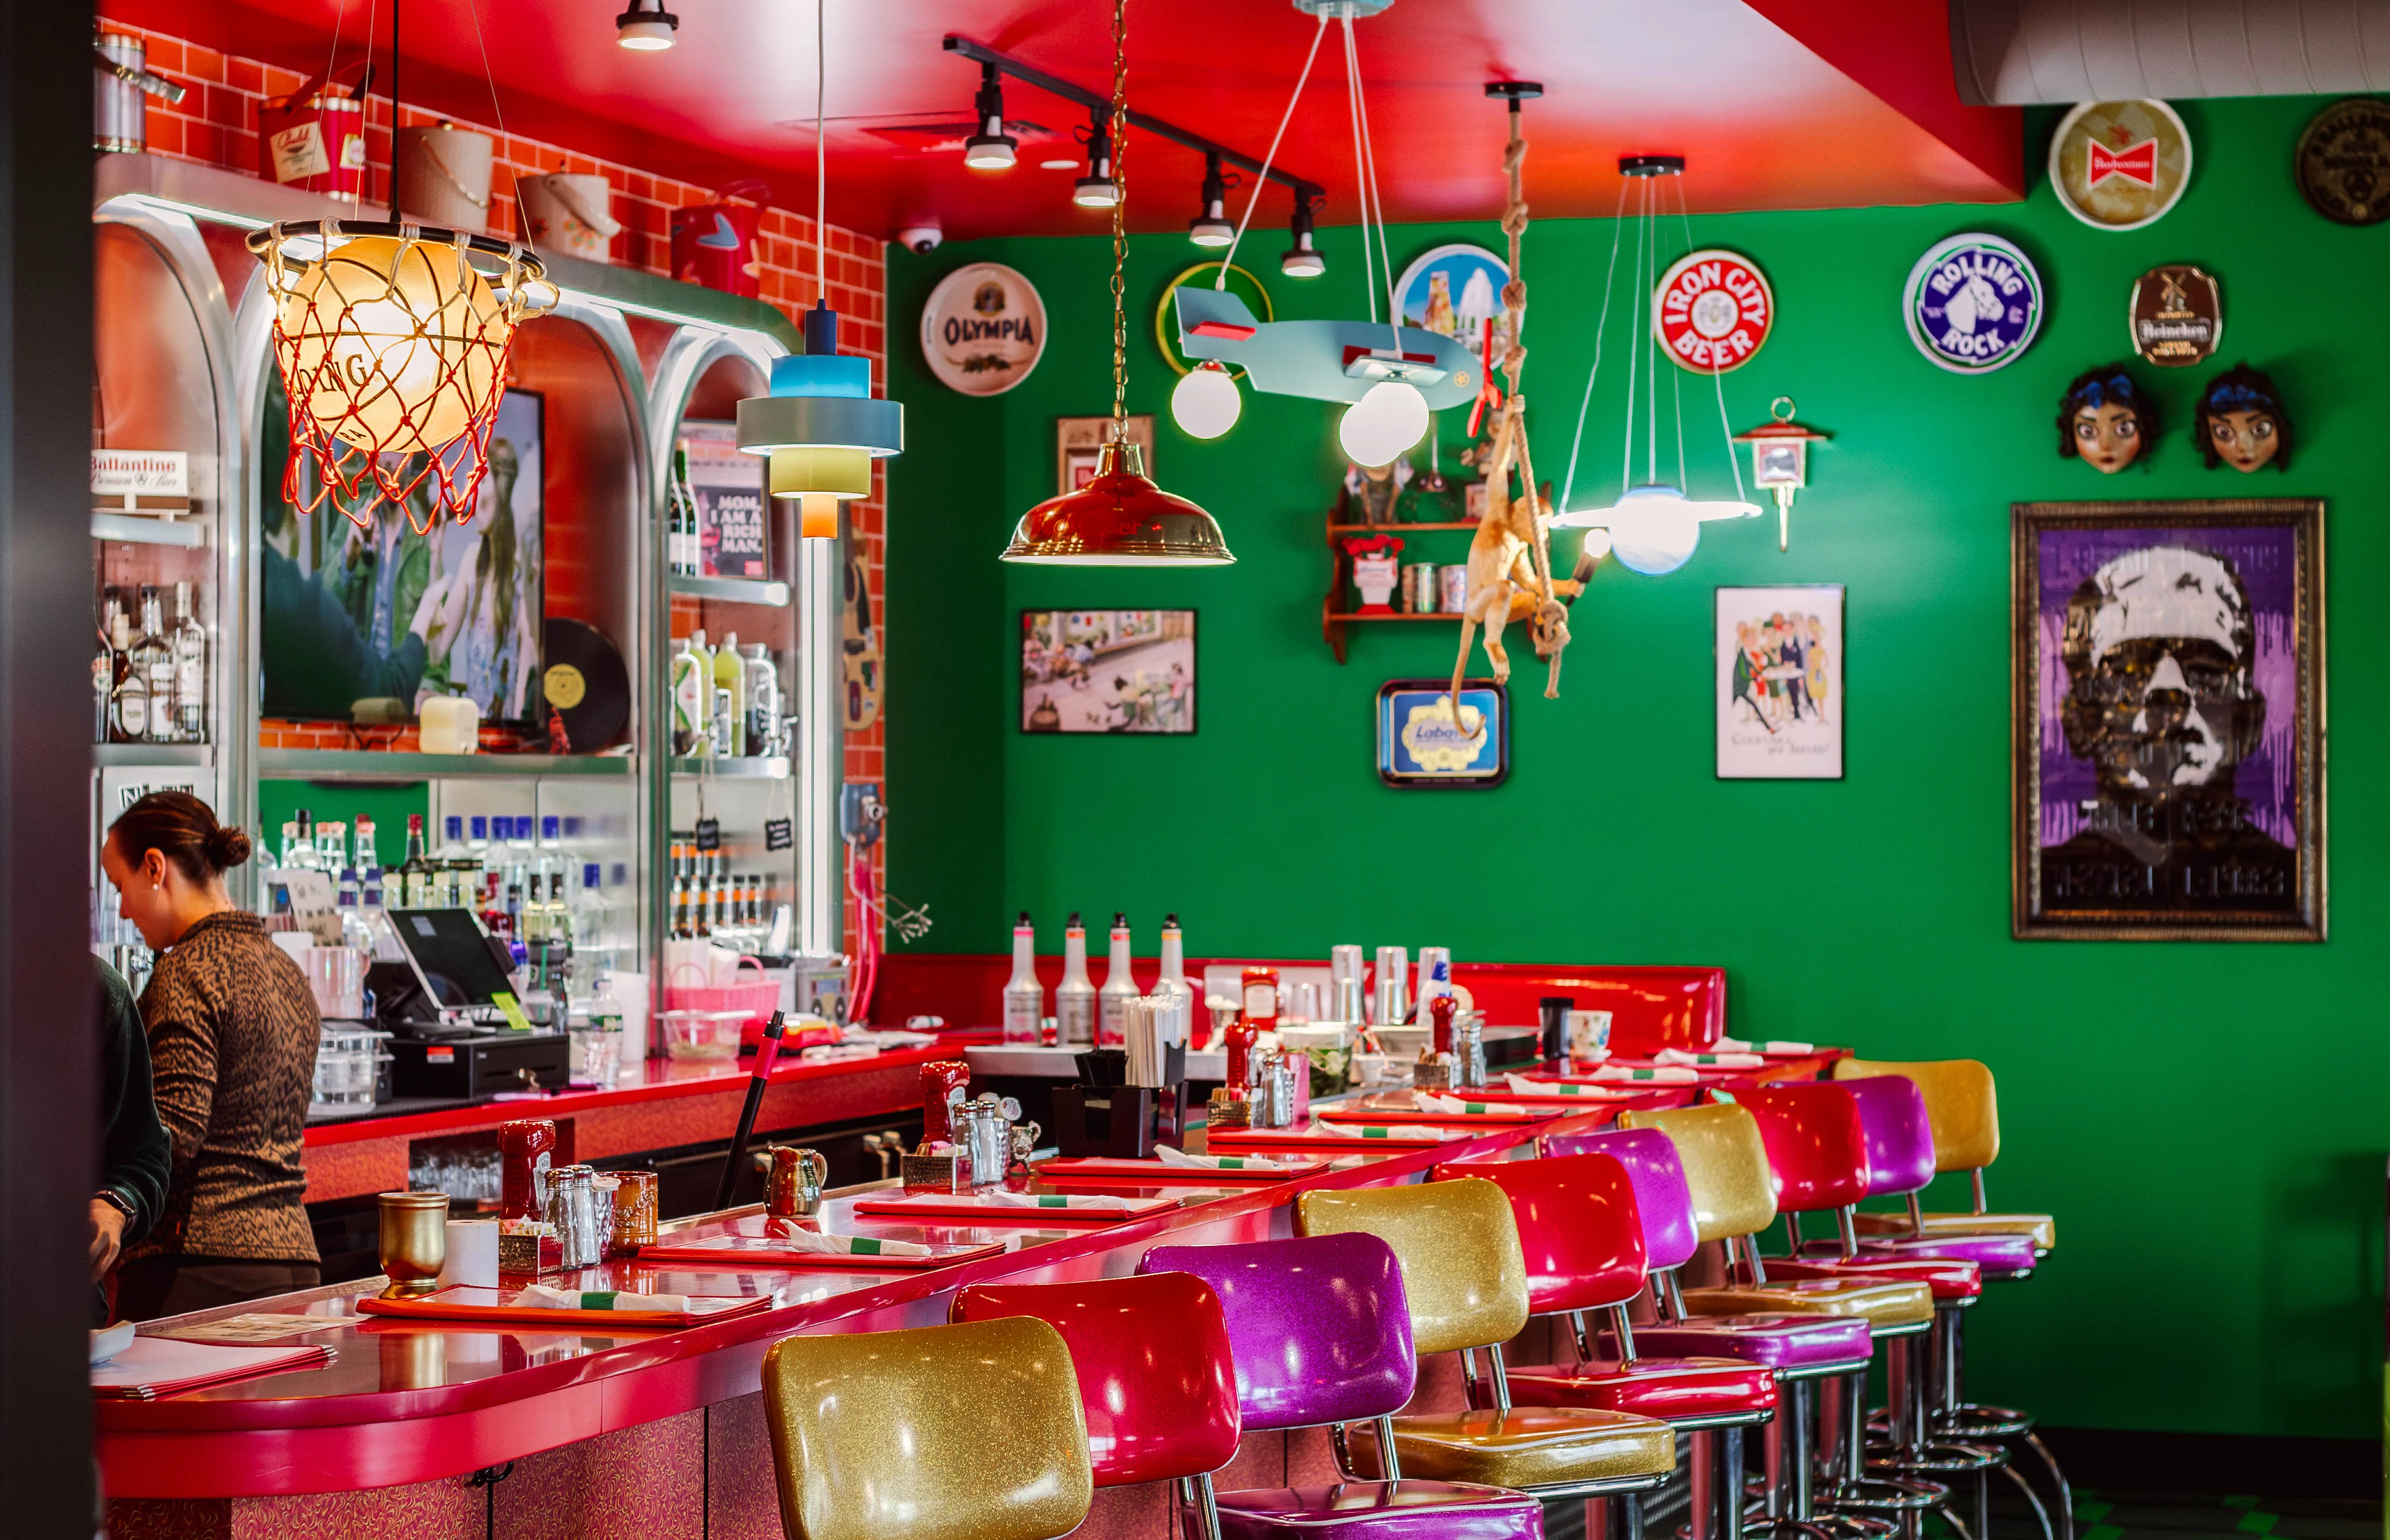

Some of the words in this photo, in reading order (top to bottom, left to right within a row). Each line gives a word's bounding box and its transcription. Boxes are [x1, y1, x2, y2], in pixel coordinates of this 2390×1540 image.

[1930, 254, 2023, 296] ROLLING
[1664, 262, 1722, 325] IRON
[1725, 268, 1766, 327] CITY
[945, 315, 1035, 346] OLYMPIA
[1941, 327, 2006, 356] ROCK
[1672, 329, 1755, 365] BEER
[711, 510, 717, 524] I
[720, 510, 746, 524] AM
[750, 510, 762, 524] A
[722, 524, 762, 539] RICH
